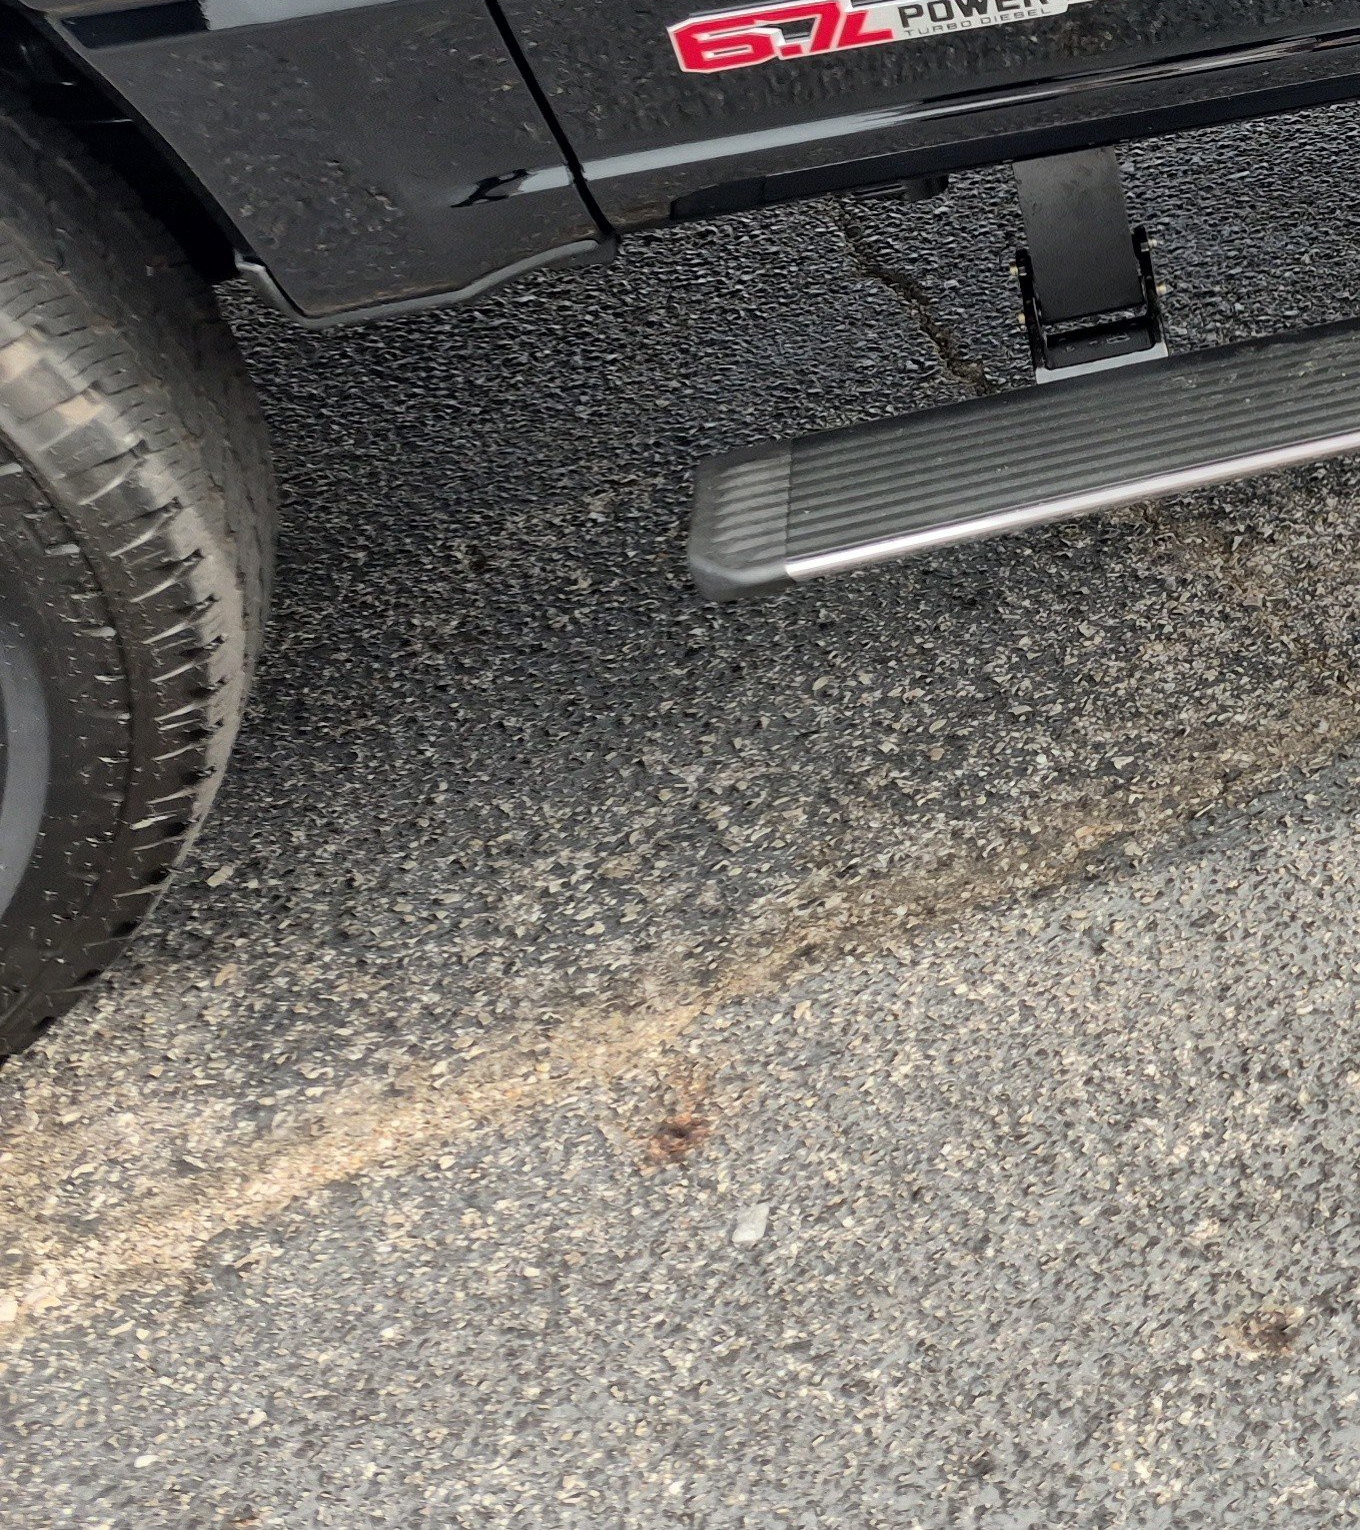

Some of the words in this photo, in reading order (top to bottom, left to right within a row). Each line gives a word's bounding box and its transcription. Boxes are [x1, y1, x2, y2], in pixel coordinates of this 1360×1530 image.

[672, 0, 894, 72] 6.7L
[902, 19, 973, 37] TURBO
[979, 7, 1052, 25] DIESEL
